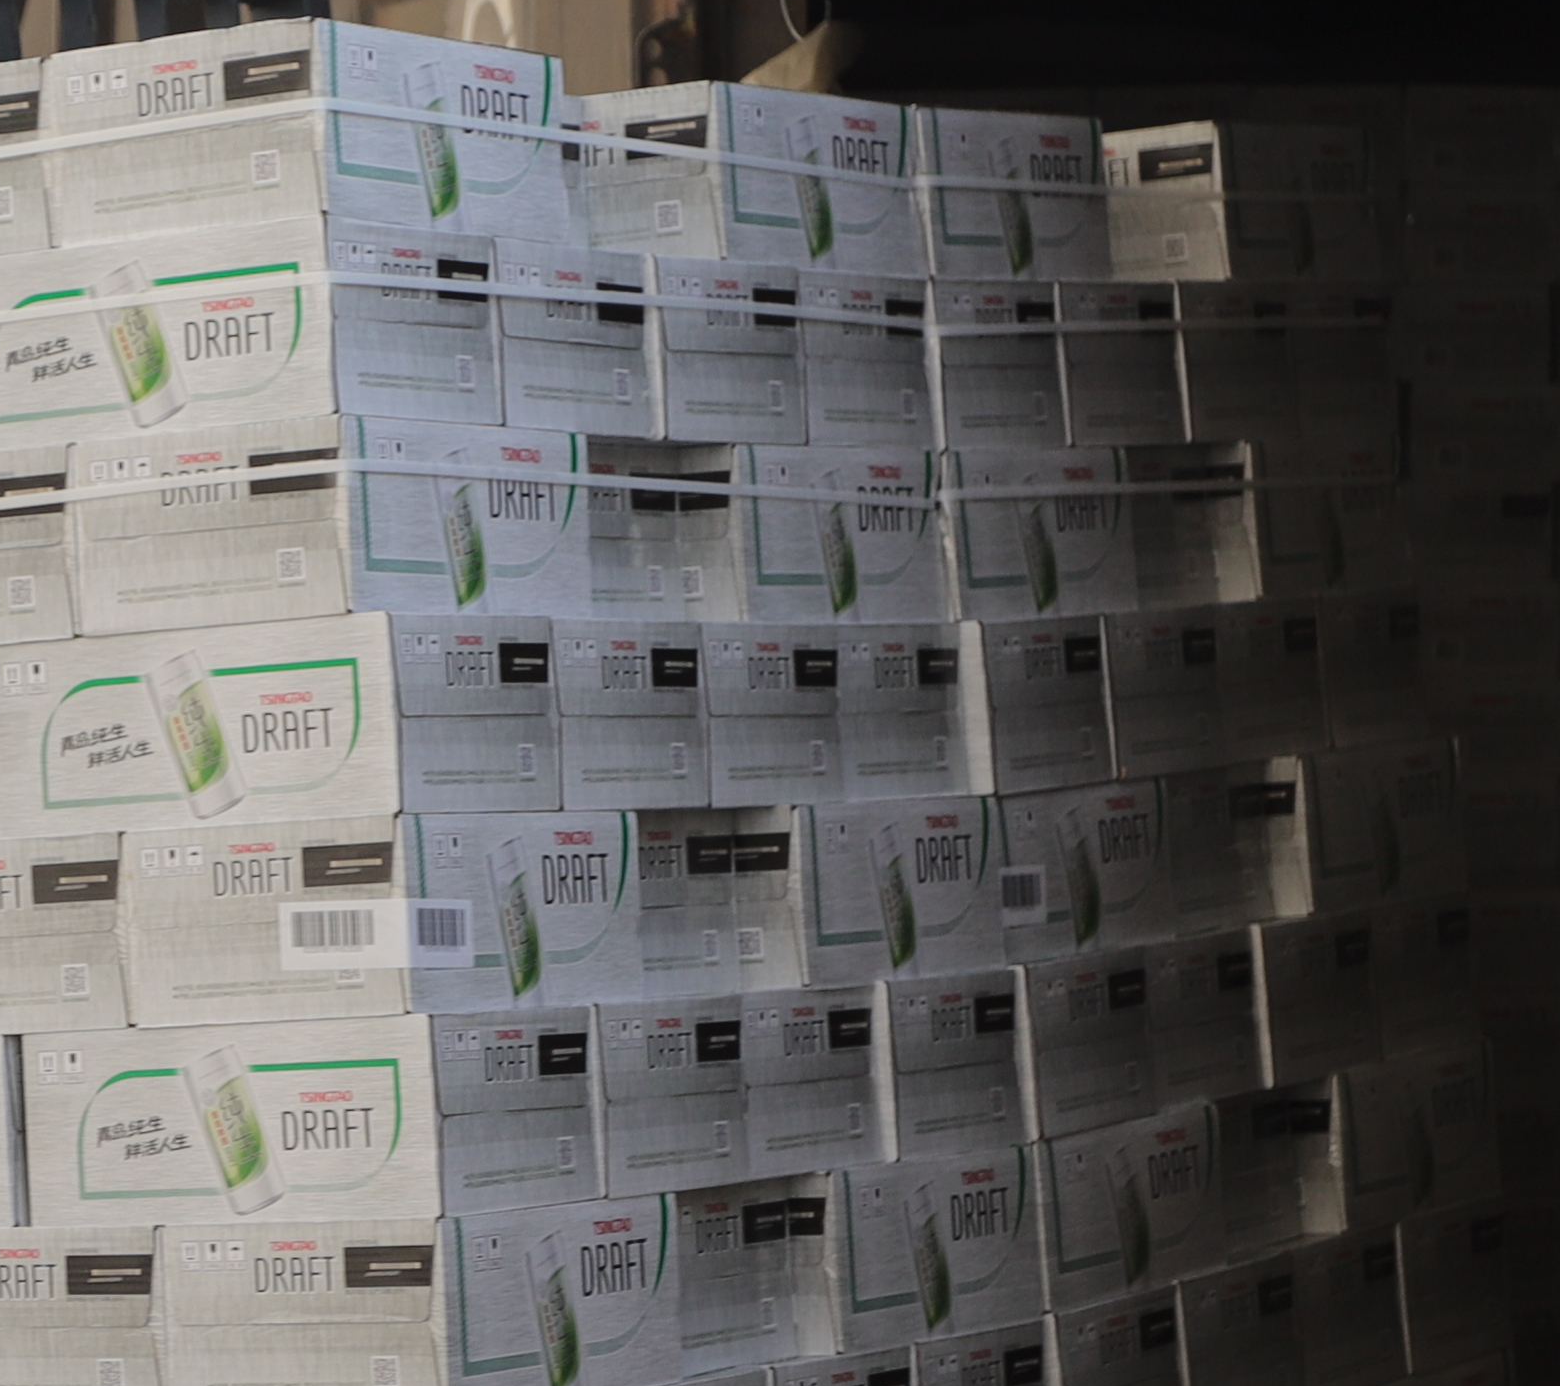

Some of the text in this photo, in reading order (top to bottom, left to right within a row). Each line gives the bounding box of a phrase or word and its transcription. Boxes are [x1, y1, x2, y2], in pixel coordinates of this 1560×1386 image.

[152, 59, 198, 75] TSINGTAO
[137, 72, 213, 117] DRAFT
[201, 296, 255, 313] TSINGTAO
[185, 312, 274, 361] DRAFT
[176, 451, 223, 465] TSINGTAO
[161, 465, 239, 506] DRAFT
[260, 691, 313, 706] TSINGTAO
[242, 707, 333, 753] DRAFT
[229, 842, 276, 855] TSINGTAO
[915, 834, 972, 884] DRAFT
[213, 857, 292, 896] DRAFT
[541, 853, 609, 905] DRAFT
[299, 1090, 354, 1104] TSINGTAO
[282, 1108, 374, 1150] DRAFT
[950, 1186, 1008, 1241] DRAFT
[270, 1240, 318, 1252] TSINGTAO
[255, 1256, 334, 1292] DRAFT
[581, 1238, 647, 1297] DRAFT
